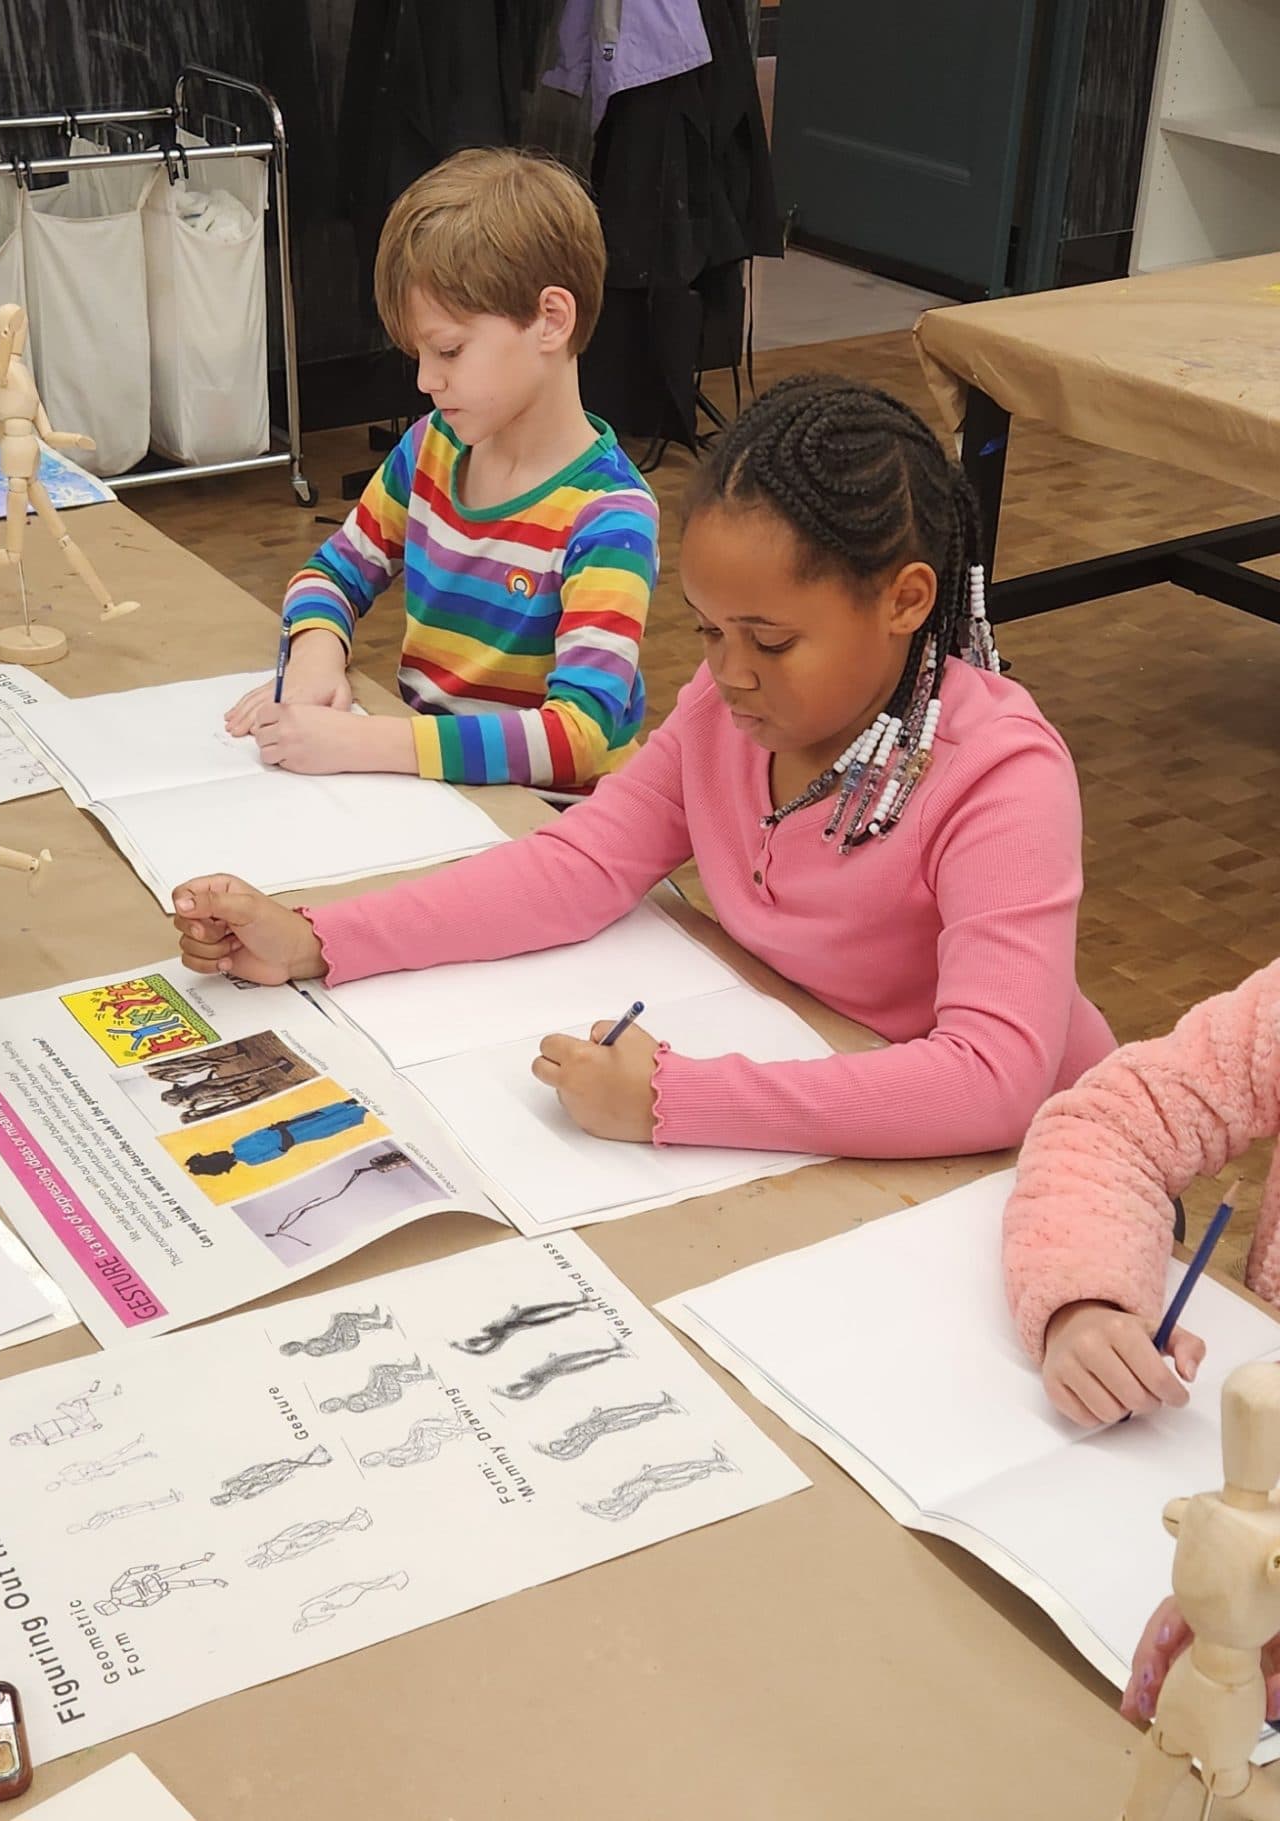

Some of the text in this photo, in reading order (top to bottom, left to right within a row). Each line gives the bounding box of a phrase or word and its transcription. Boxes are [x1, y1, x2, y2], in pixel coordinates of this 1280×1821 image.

[61, 1068, 78, 1080] you
[70, 1078, 98, 1105] gestures
[12, 1134, 26, 1147] or
[20, 1145, 42, 1170] ideas
[119, 1141, 144, 1168] describe
[140, 1168, 152, 1176] to
[144, 1176, 165, 1192] word
[36, 1167, 74, 1214] expressing
[98, 1189, 123, 1215] gestures
[65, 1213, 81, 1224] of
[171, 1206, 192, 1223] think
[76, 1223, 95, 1242] way
[188, 1222, 206, 1235] you
[90, 1241, 100, 1249] a
[94, 1248, 107, 1258] is
[199, 1235, 213, 1248] Can
[96, 1256, 157, 1319] GESTURE
[543, 1243, 632, 1338] Weight and Mass
[269, 1387, 309, 1440] Gesture
[478, 1462, 515, 1504] Form:
[70, 1599, 120, 1684] Geometric
[115, 1632, 145, 1676] Form
[22, 1617, 84, 1724] Figuring
